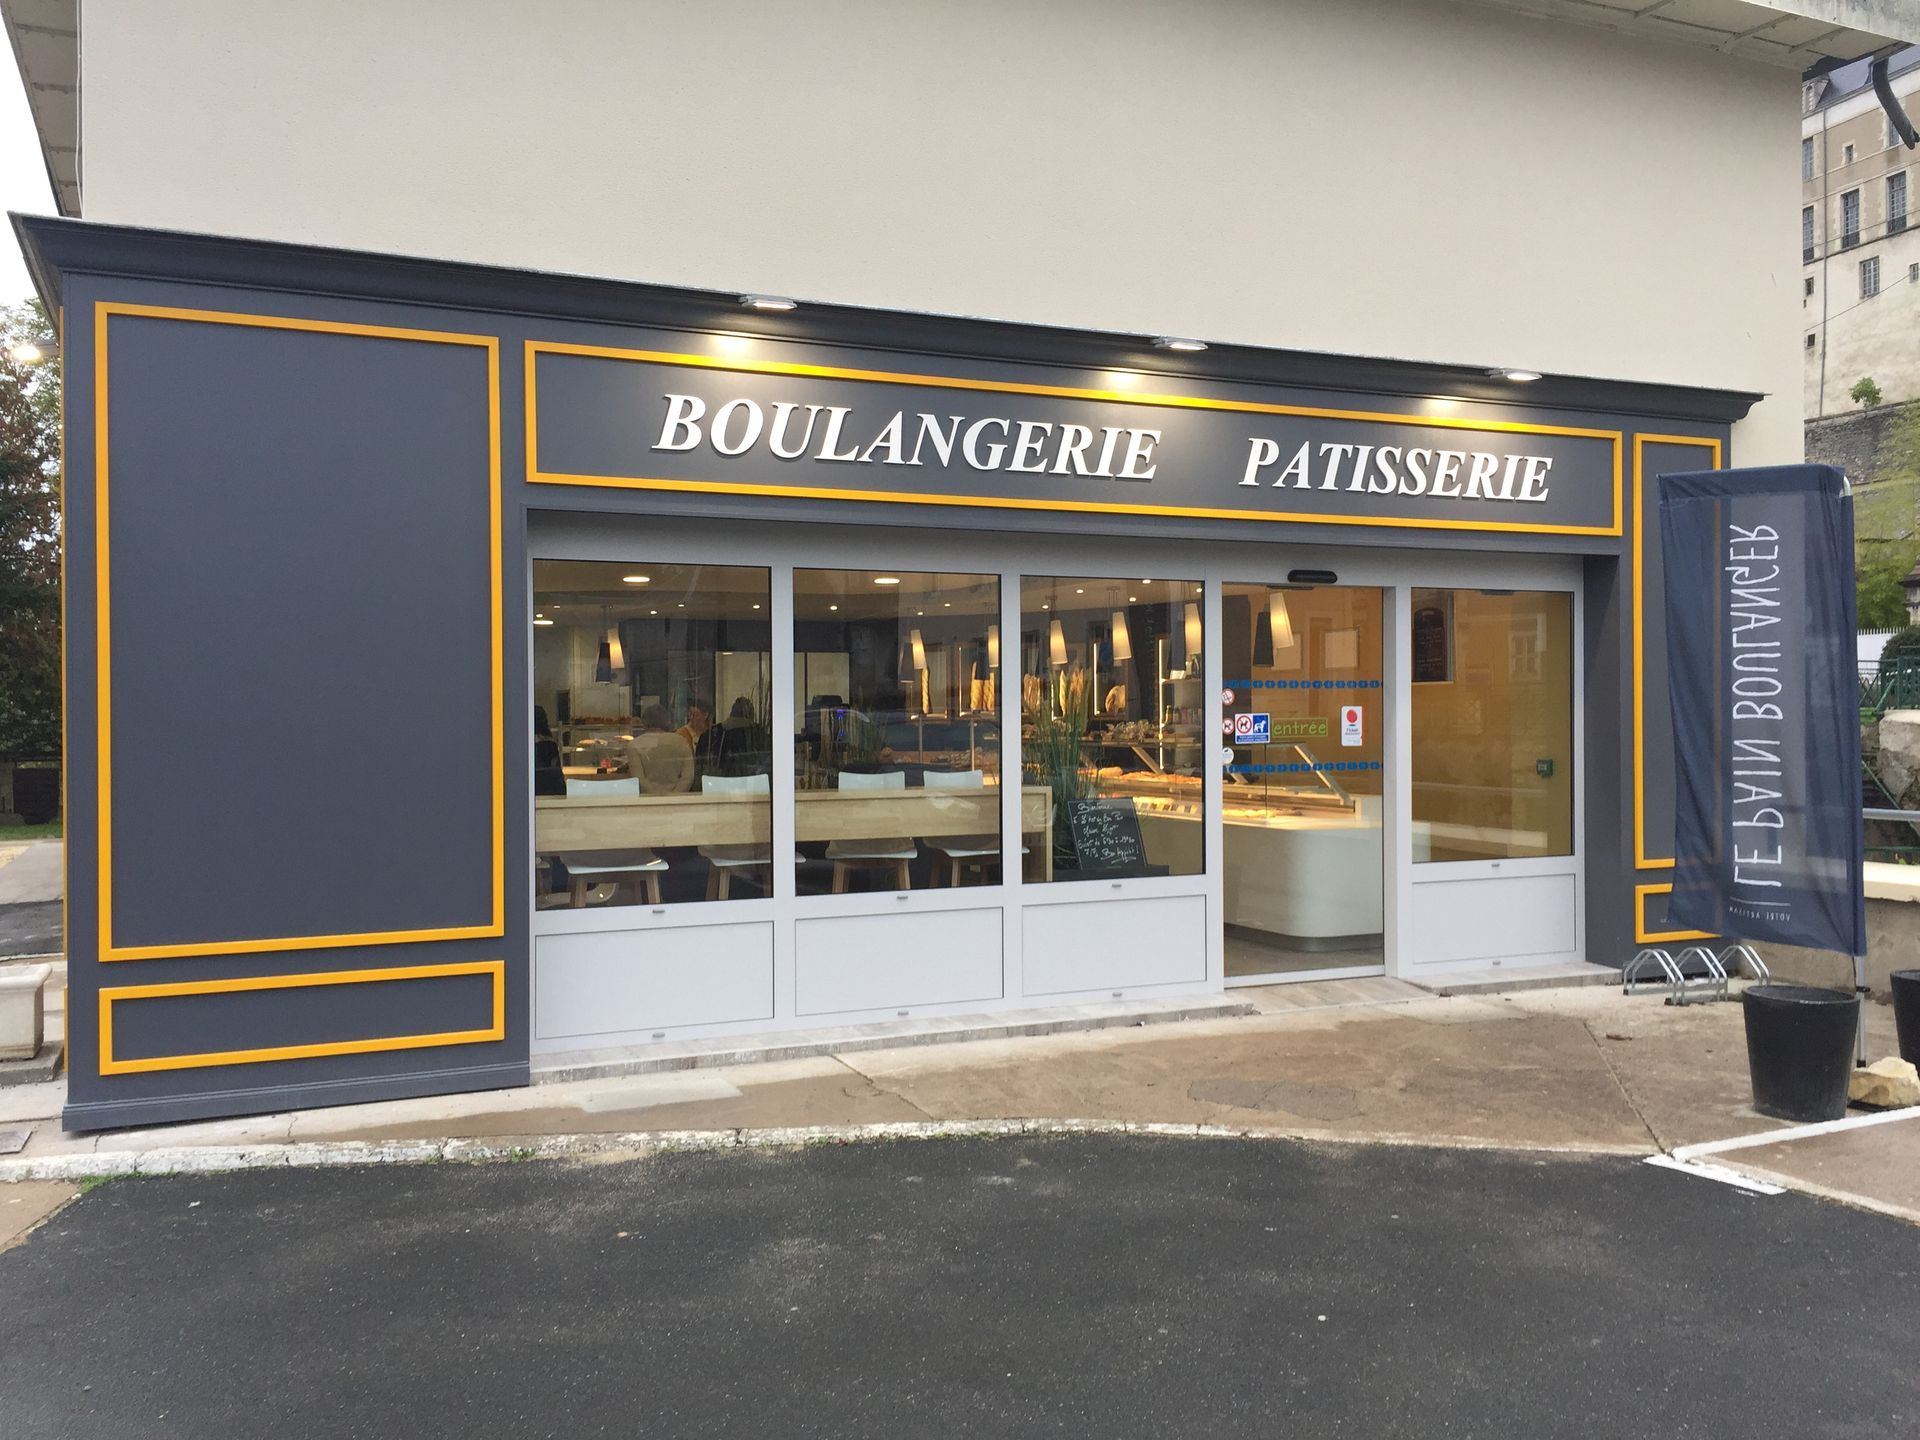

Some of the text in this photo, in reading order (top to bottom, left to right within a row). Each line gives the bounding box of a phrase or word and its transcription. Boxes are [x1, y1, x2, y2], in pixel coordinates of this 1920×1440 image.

[651, 393, 1553, 502] BOULANGERIE PATISSERIE
[1273, 721, 1326, 736] entrée
